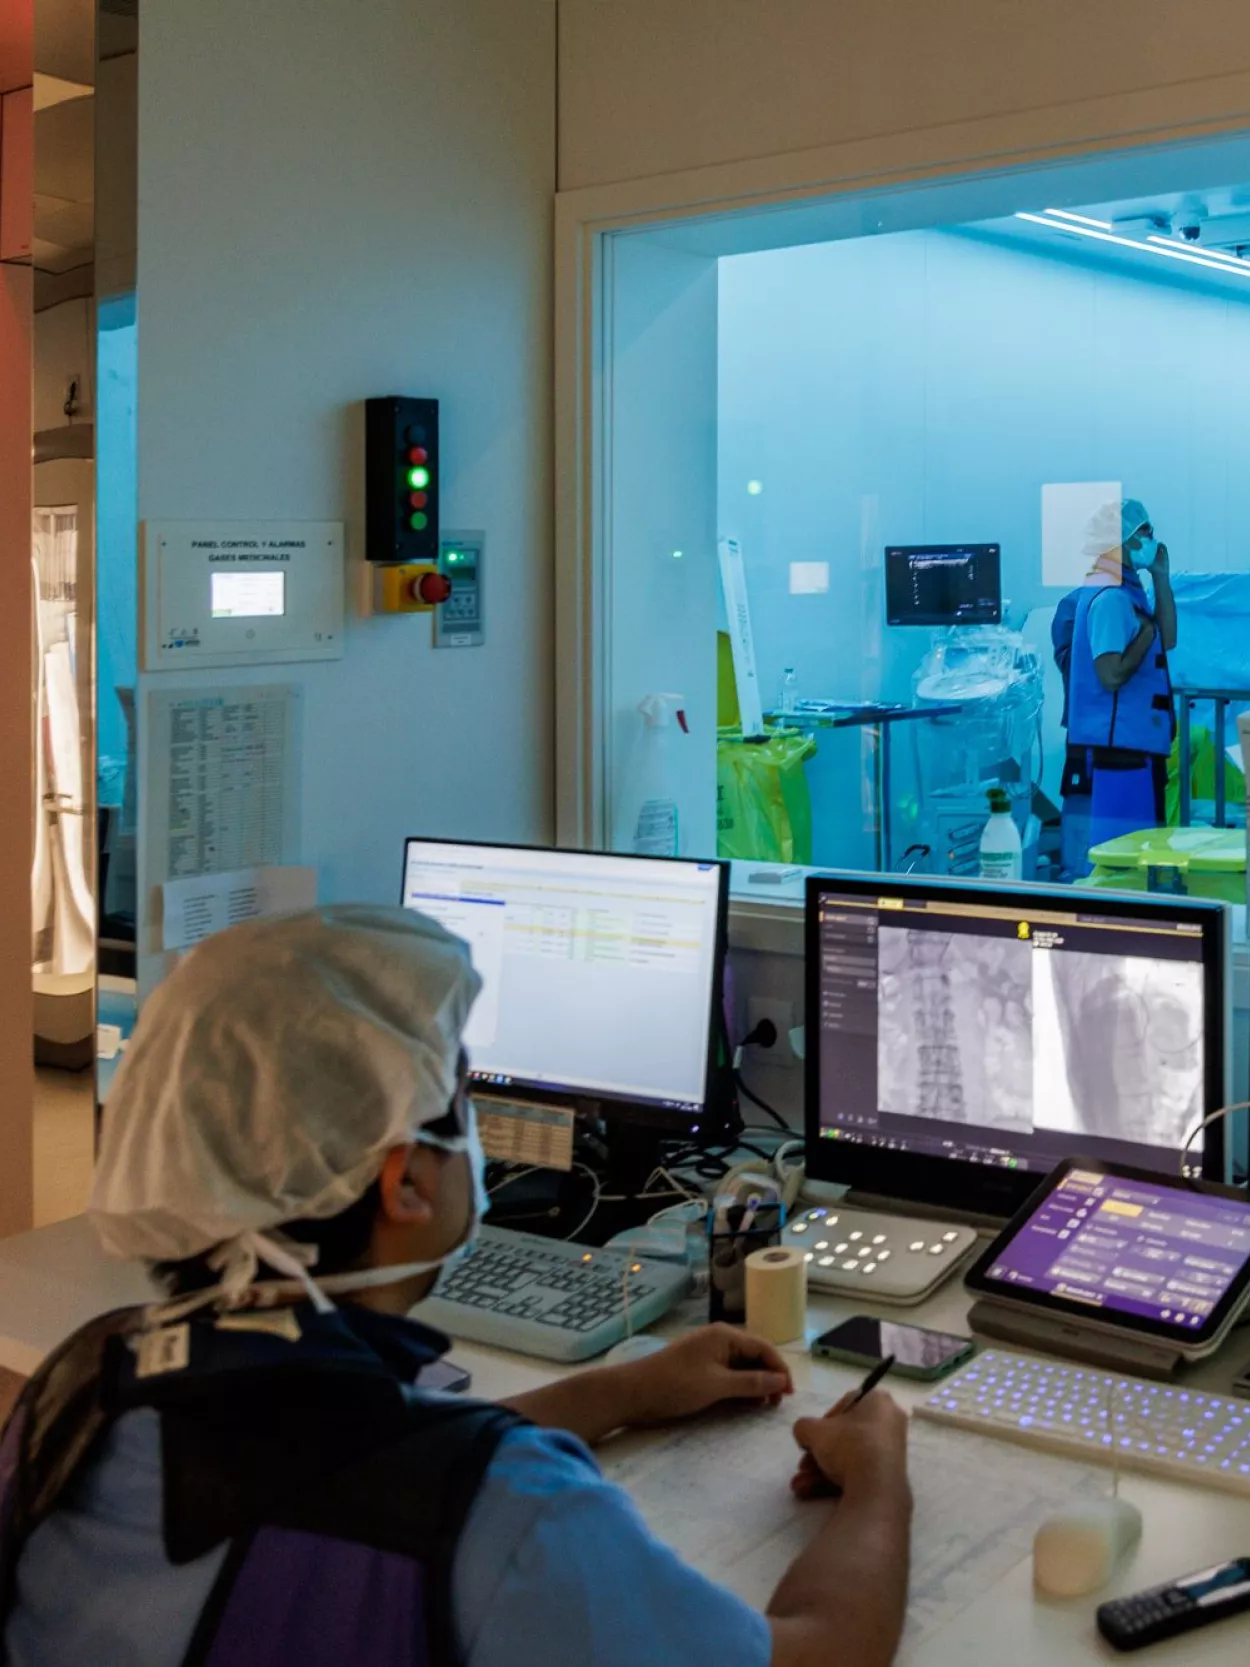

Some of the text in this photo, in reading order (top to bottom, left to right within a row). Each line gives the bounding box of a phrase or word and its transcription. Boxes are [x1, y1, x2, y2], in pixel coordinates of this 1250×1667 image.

[191, 540, 219, 549] PANEL
[220, 540, 259, 549] CONTROL
[268, 540, 306, 549] ALARMAS
[208, 553, 290, 562] GASES MEDICINALES
